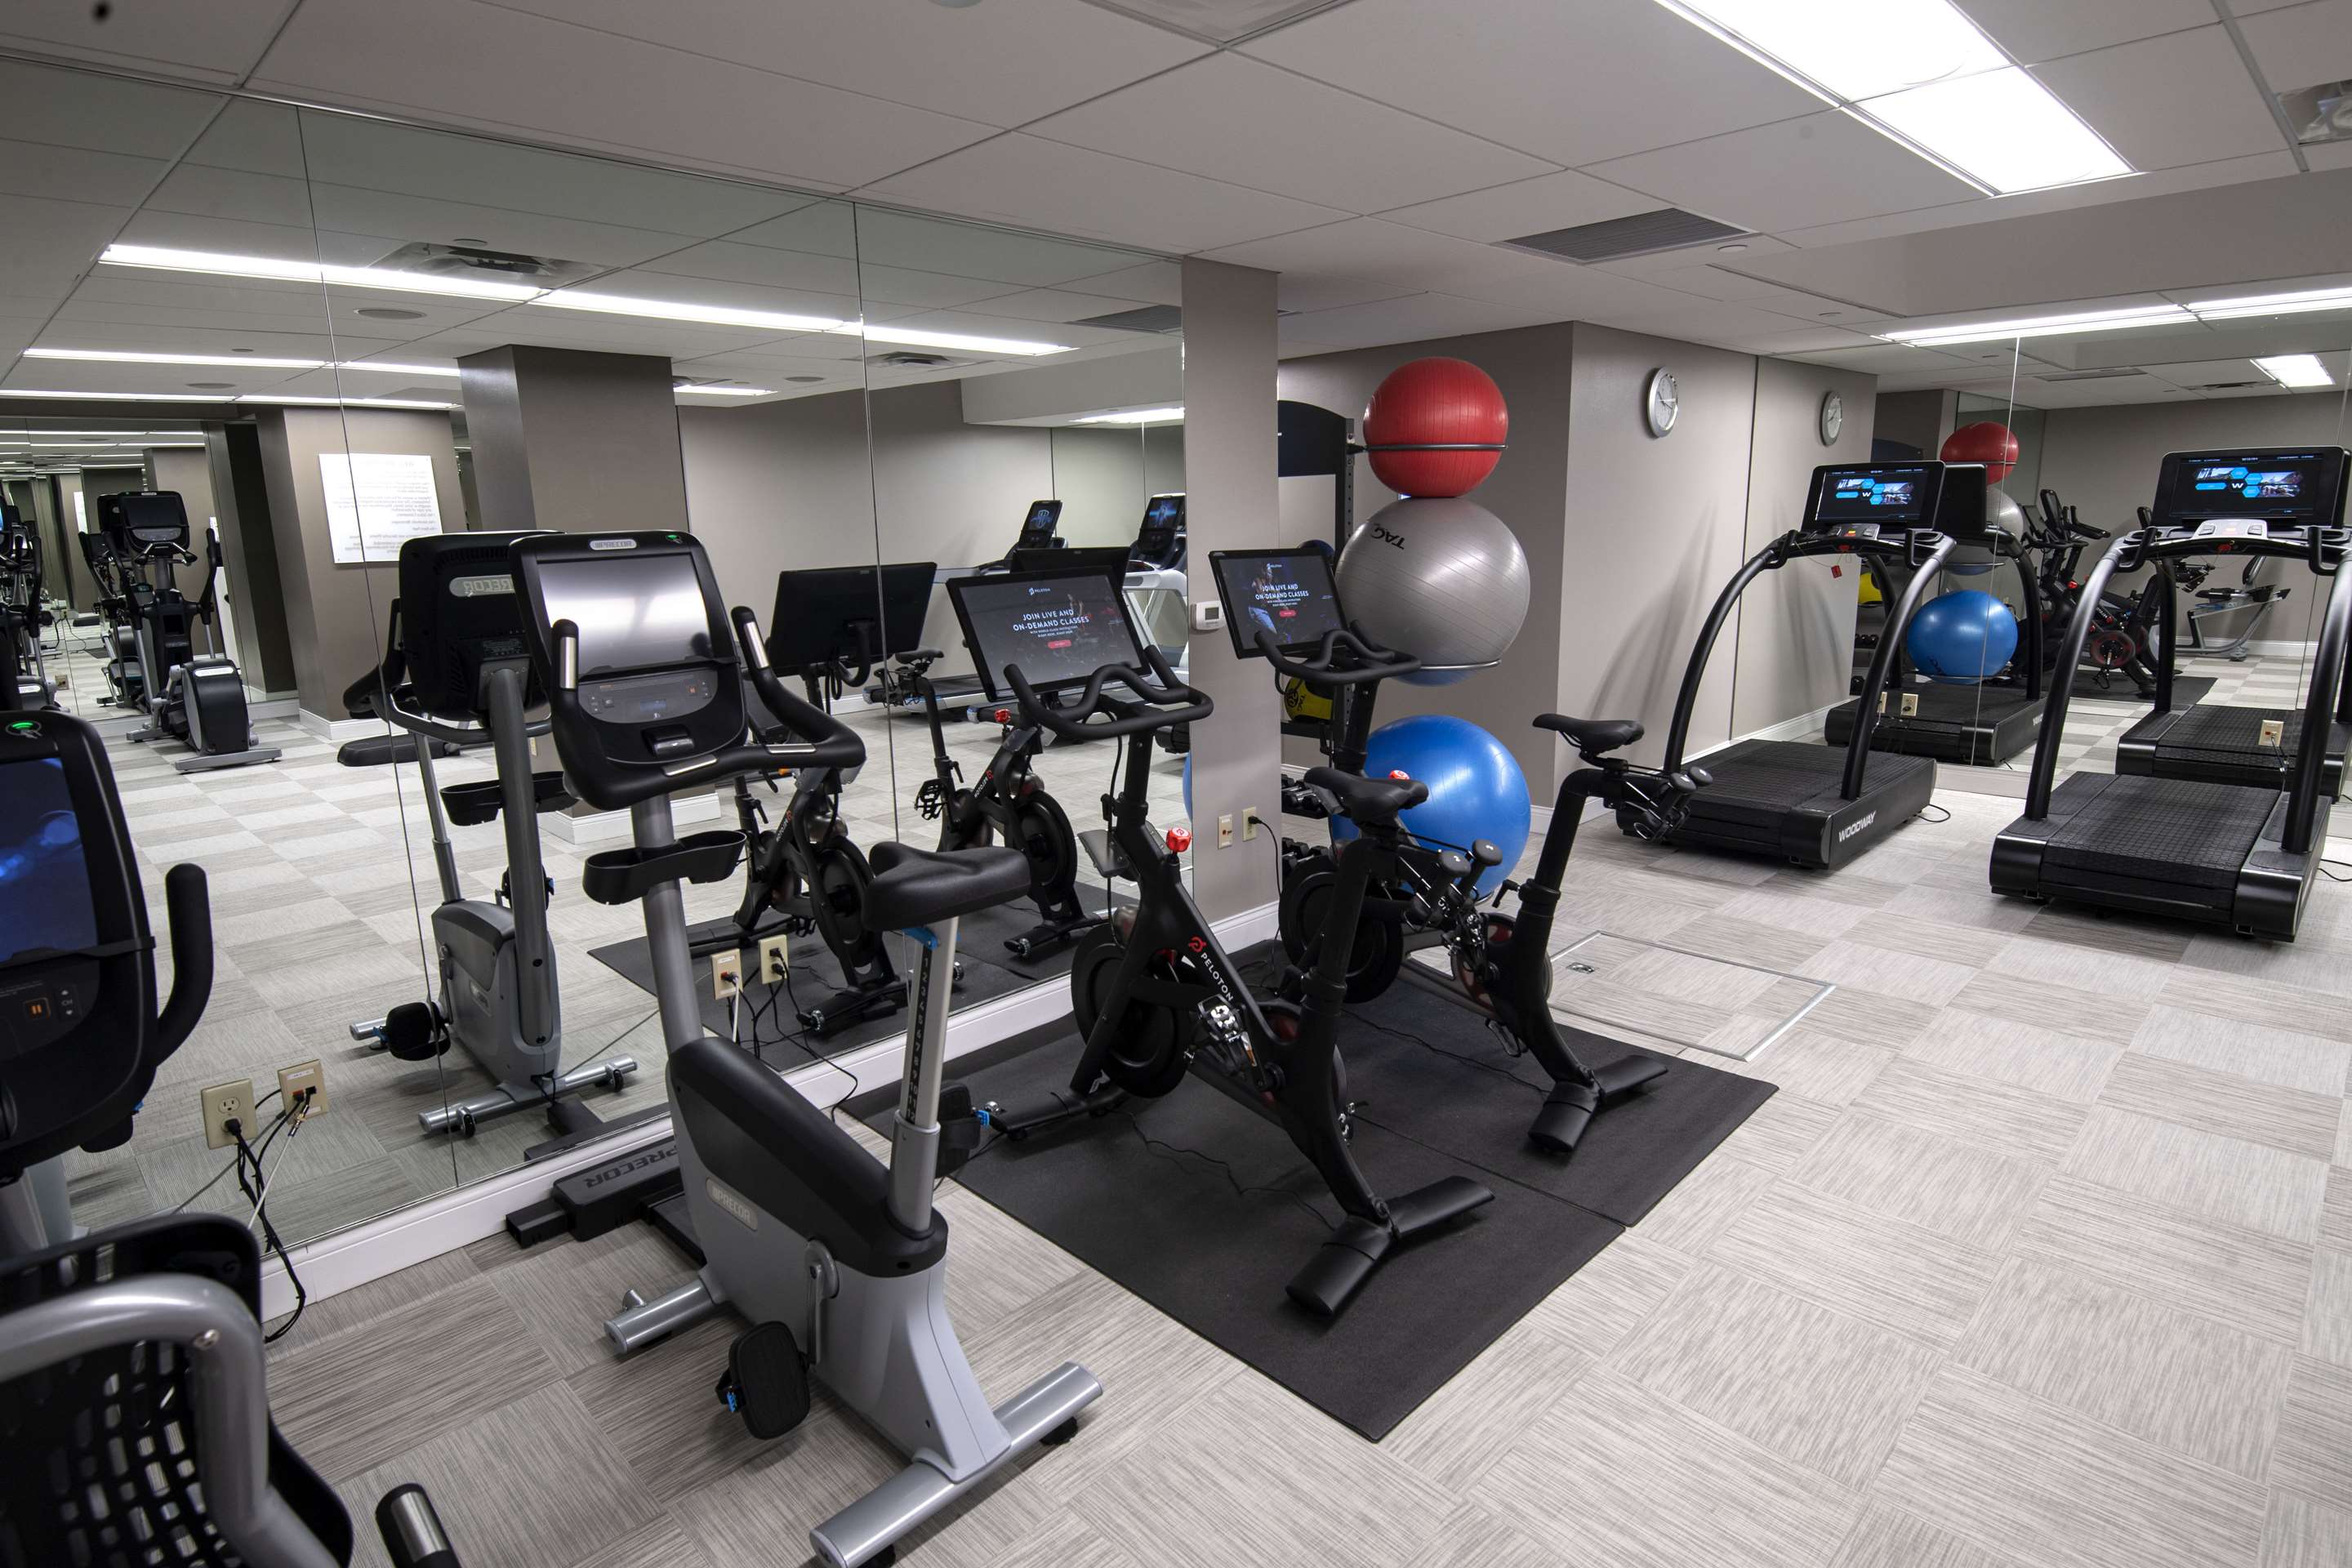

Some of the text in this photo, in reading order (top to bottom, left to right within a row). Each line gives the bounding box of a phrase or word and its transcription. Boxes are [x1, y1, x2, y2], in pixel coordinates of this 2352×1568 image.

[1371, 527, 1405, 550] TAG
[1255, 591, 1287, 600] ON-DEMAND
[1262, 584, 1275, 592] JOIN
[1013, 616, 1089, 631] ON-DEMAND CLASSES
[1022, 608, 1074, 621] JOIN LIVE AND
[1838, 809, 1877, 842] WOODWAY
[1200, 951, 1234, 1001] PELOTON
[583, 1145, 679, 1189] PRECOR
